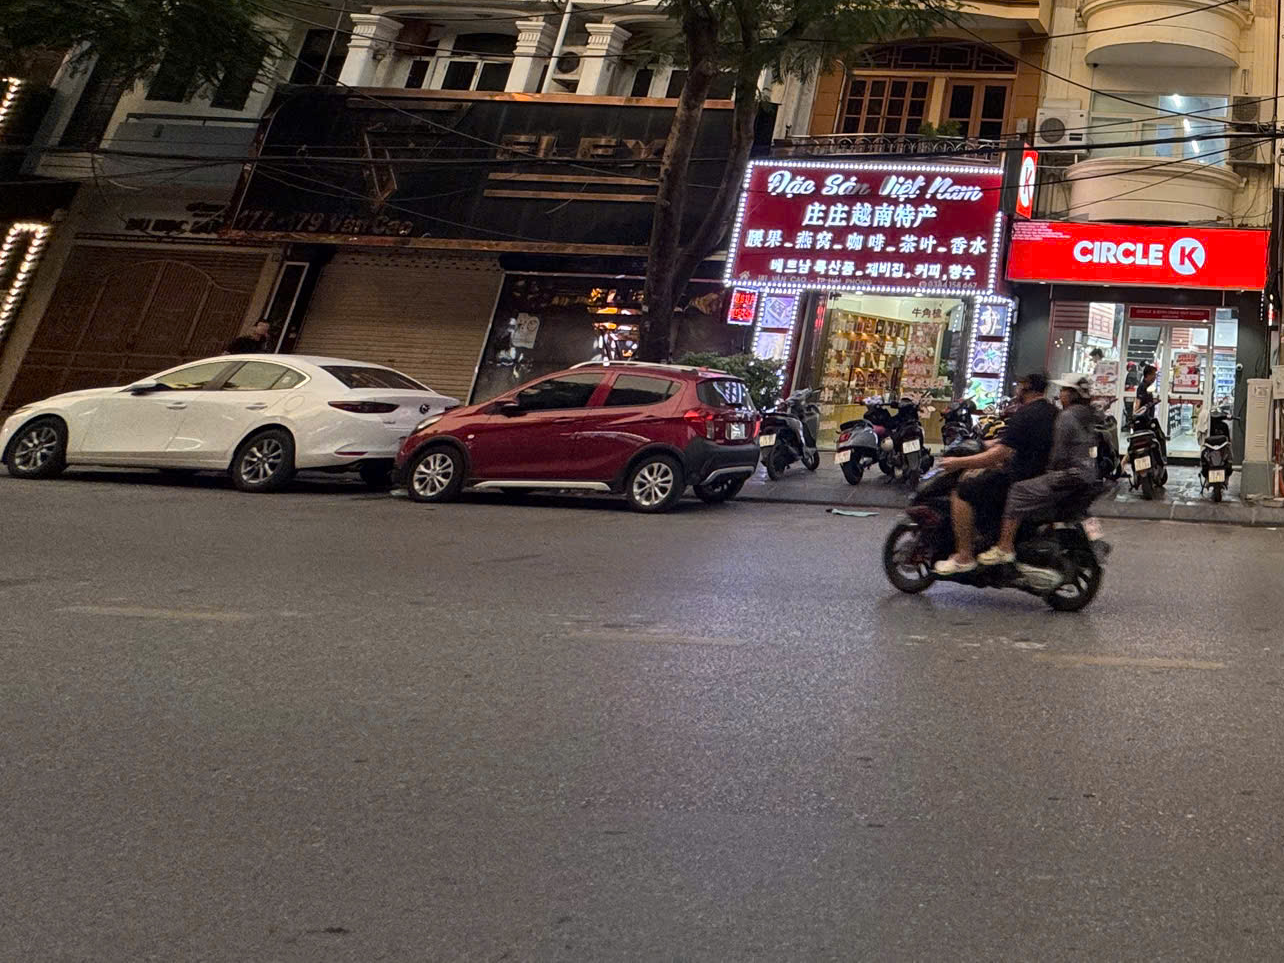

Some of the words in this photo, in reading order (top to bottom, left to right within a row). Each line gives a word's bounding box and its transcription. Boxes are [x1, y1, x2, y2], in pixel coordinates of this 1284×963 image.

[925, 175, 984, 201] Nam
[801, 201, 938, 228] 庄庄越南特产
[1073, 240, 1164, 266] CIRCLE
[1174, 242, 1204, 274] K
